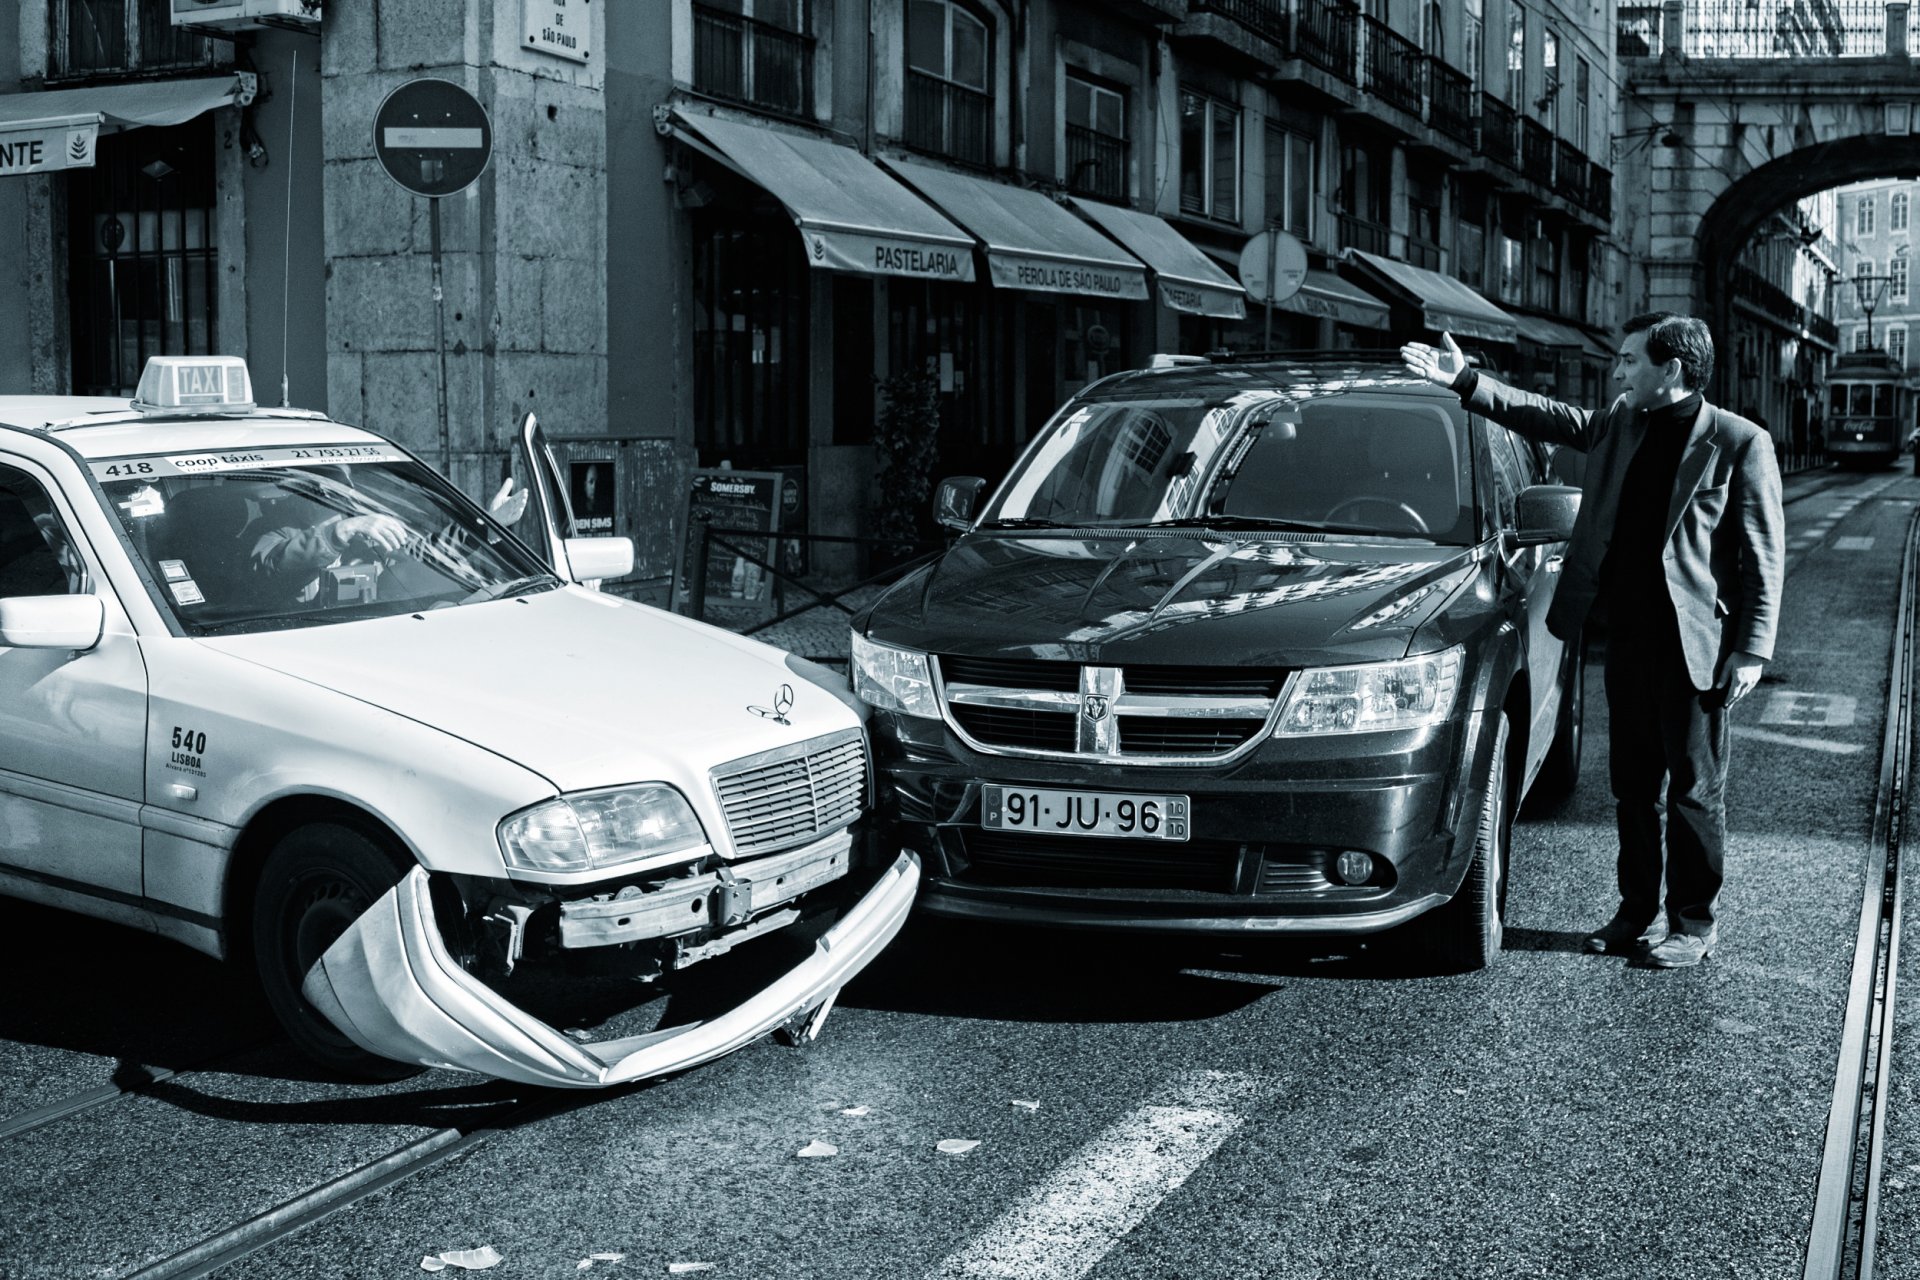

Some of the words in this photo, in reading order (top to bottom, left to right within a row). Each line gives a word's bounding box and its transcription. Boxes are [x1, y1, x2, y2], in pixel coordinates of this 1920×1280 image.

[556, 13, 564, 26] DE
[543, 27, 555, 43] SÃO
[557, 32, 577, 49] PAULO
[0, 140, 43, 168] NTE
[875, 246, 959, 275] PASTELARIA
[1018, 262, 1057, 286] PÉROLA
[1059, 270, 1072, 288] DE
[1073, 268, 1092, 289] SÃO
[1094, 274, 1121, 293] PAULO
[180, 367, 222, 394] TAXI
[175, 457, 218, 467] coop
[221, 453, 264, 463] táxis
[291, 450, 313, 458] 21
[314, 449, 343, 457] 793
[105, 462, 154, 477] 418
[710, 482, 755, 494] SOMERSBY
[592, 517, 612, 529] SIMS
[171, 726, 206, 754] 540
[171, 752, 202, 769] LISBOA
[1170, 801, 1185, 815] 10
[989, 812, 998, 821] P
[1170, 822, 1185, 835] 10
